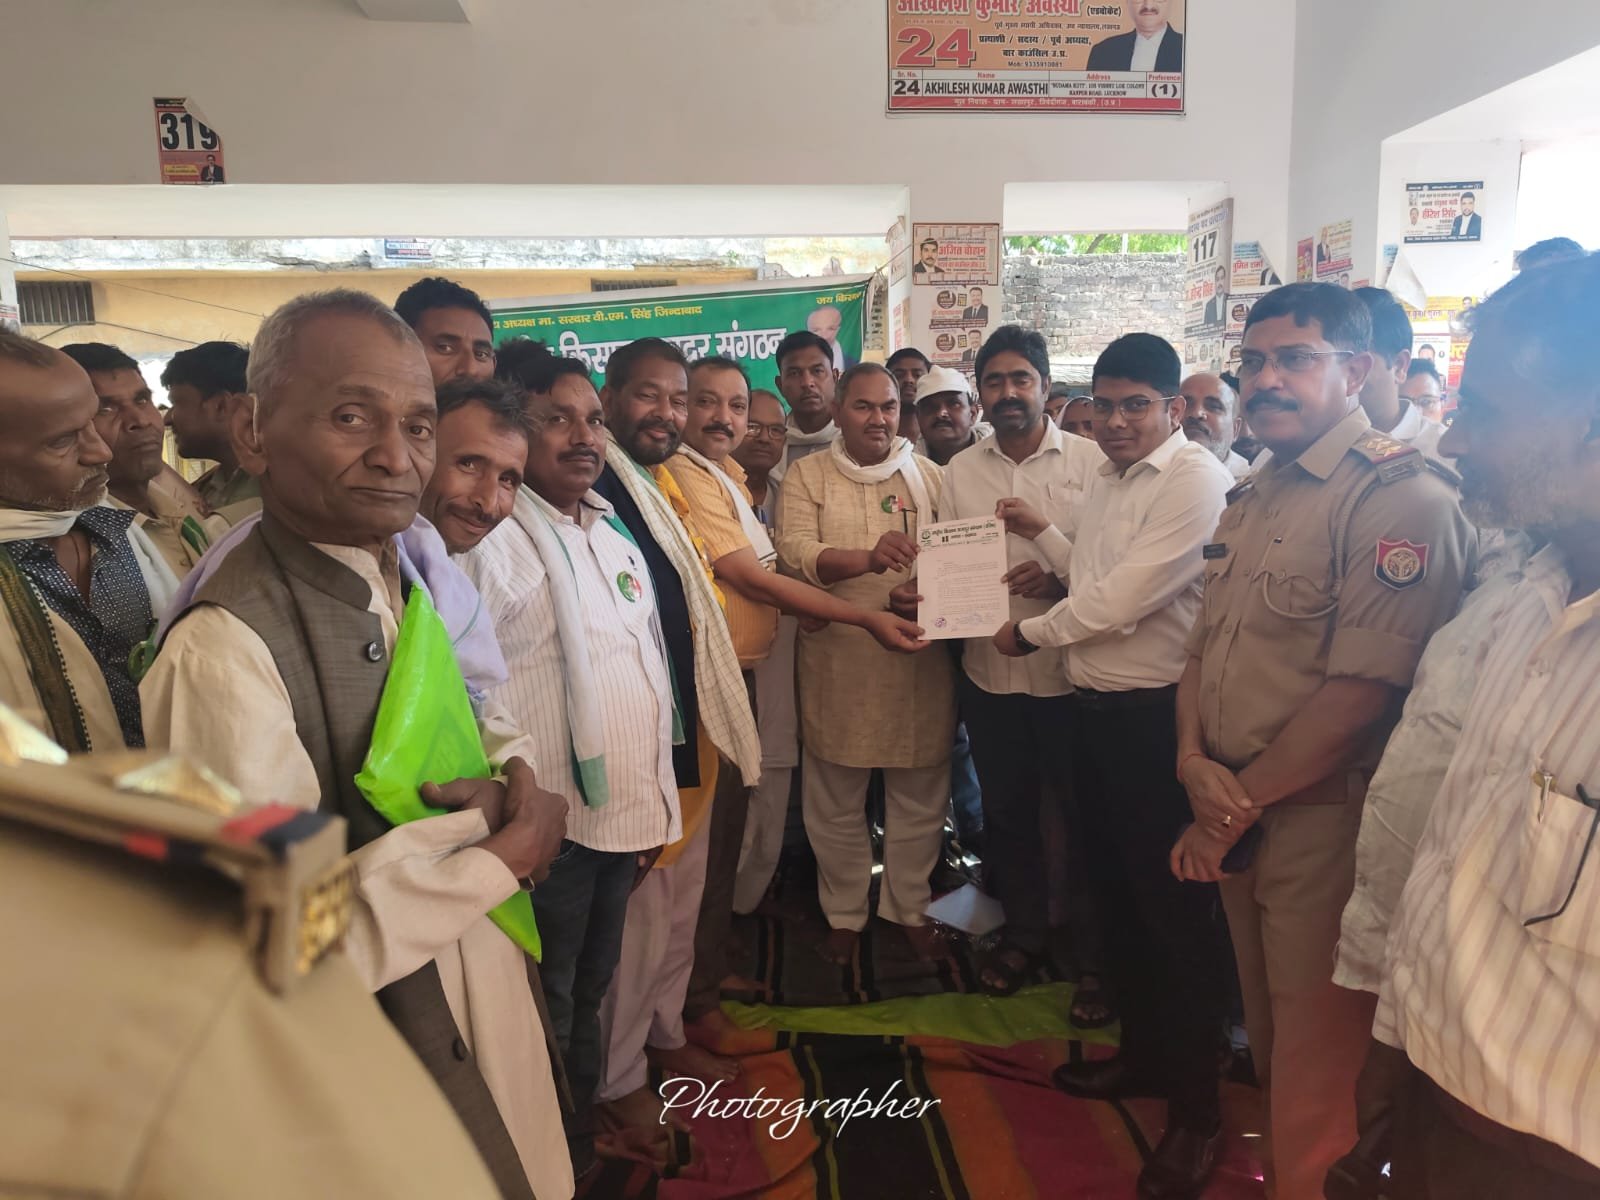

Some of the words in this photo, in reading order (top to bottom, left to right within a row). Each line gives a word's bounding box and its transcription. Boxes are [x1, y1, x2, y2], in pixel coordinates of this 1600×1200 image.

[1018, 35, 1039, 44] सदस्य
[896, 27, 976, 67] 24
[894, 80, 920, 95] 24
[924, 82, 970, 95] AKHILESH
[972, 83, 1006, 95] KUMAR
[1007, 83, 1049, 95] AWASTHI
[1151, 84, 1178, 98] (1)
[160, 112, 218, 150] 319
[1193, 231, 1217, 263] 117
[631, 307, 653, 319] सिंह
